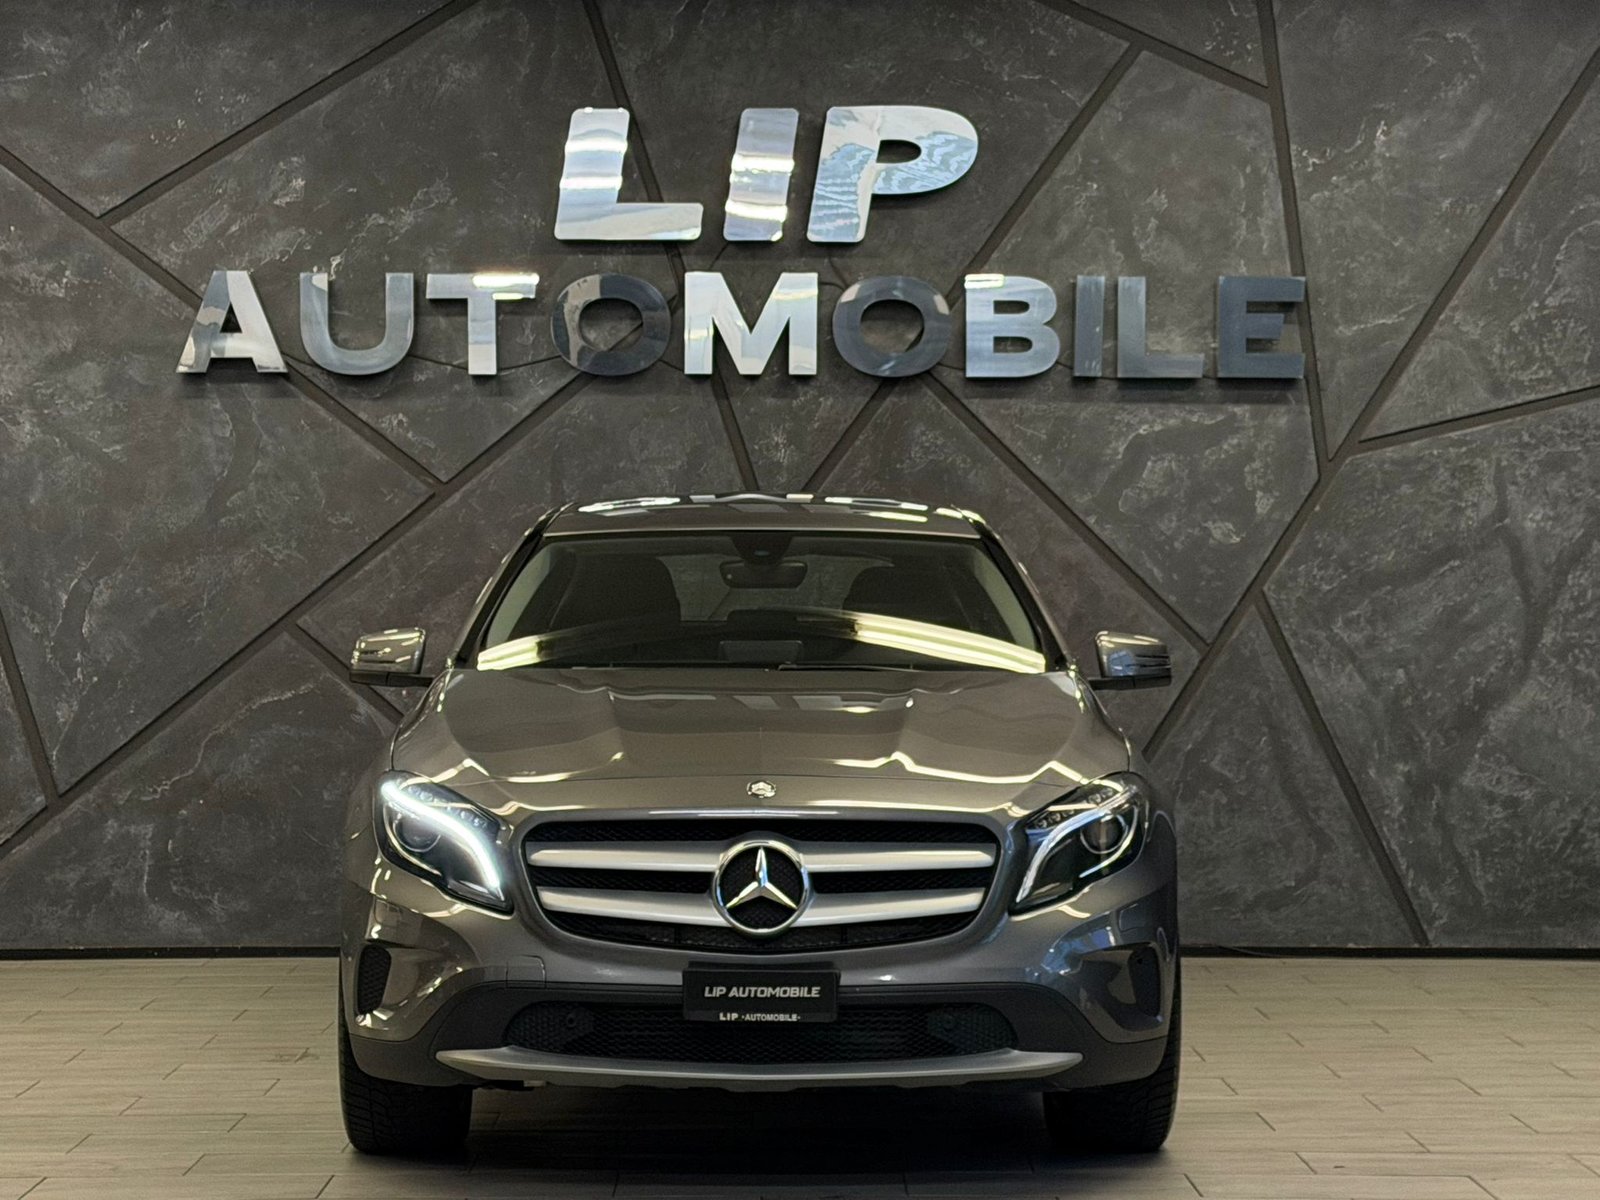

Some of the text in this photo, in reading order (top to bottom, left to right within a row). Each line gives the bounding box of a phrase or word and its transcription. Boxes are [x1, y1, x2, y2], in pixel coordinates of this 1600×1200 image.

[554, 105, 979, 243] LIP
[176, 269, 1306, 379] AUTOMOBILE
[704, 986, 821, 998] LIP AUTOMOBILE
[719, 1012, 738, 1021] LIP
